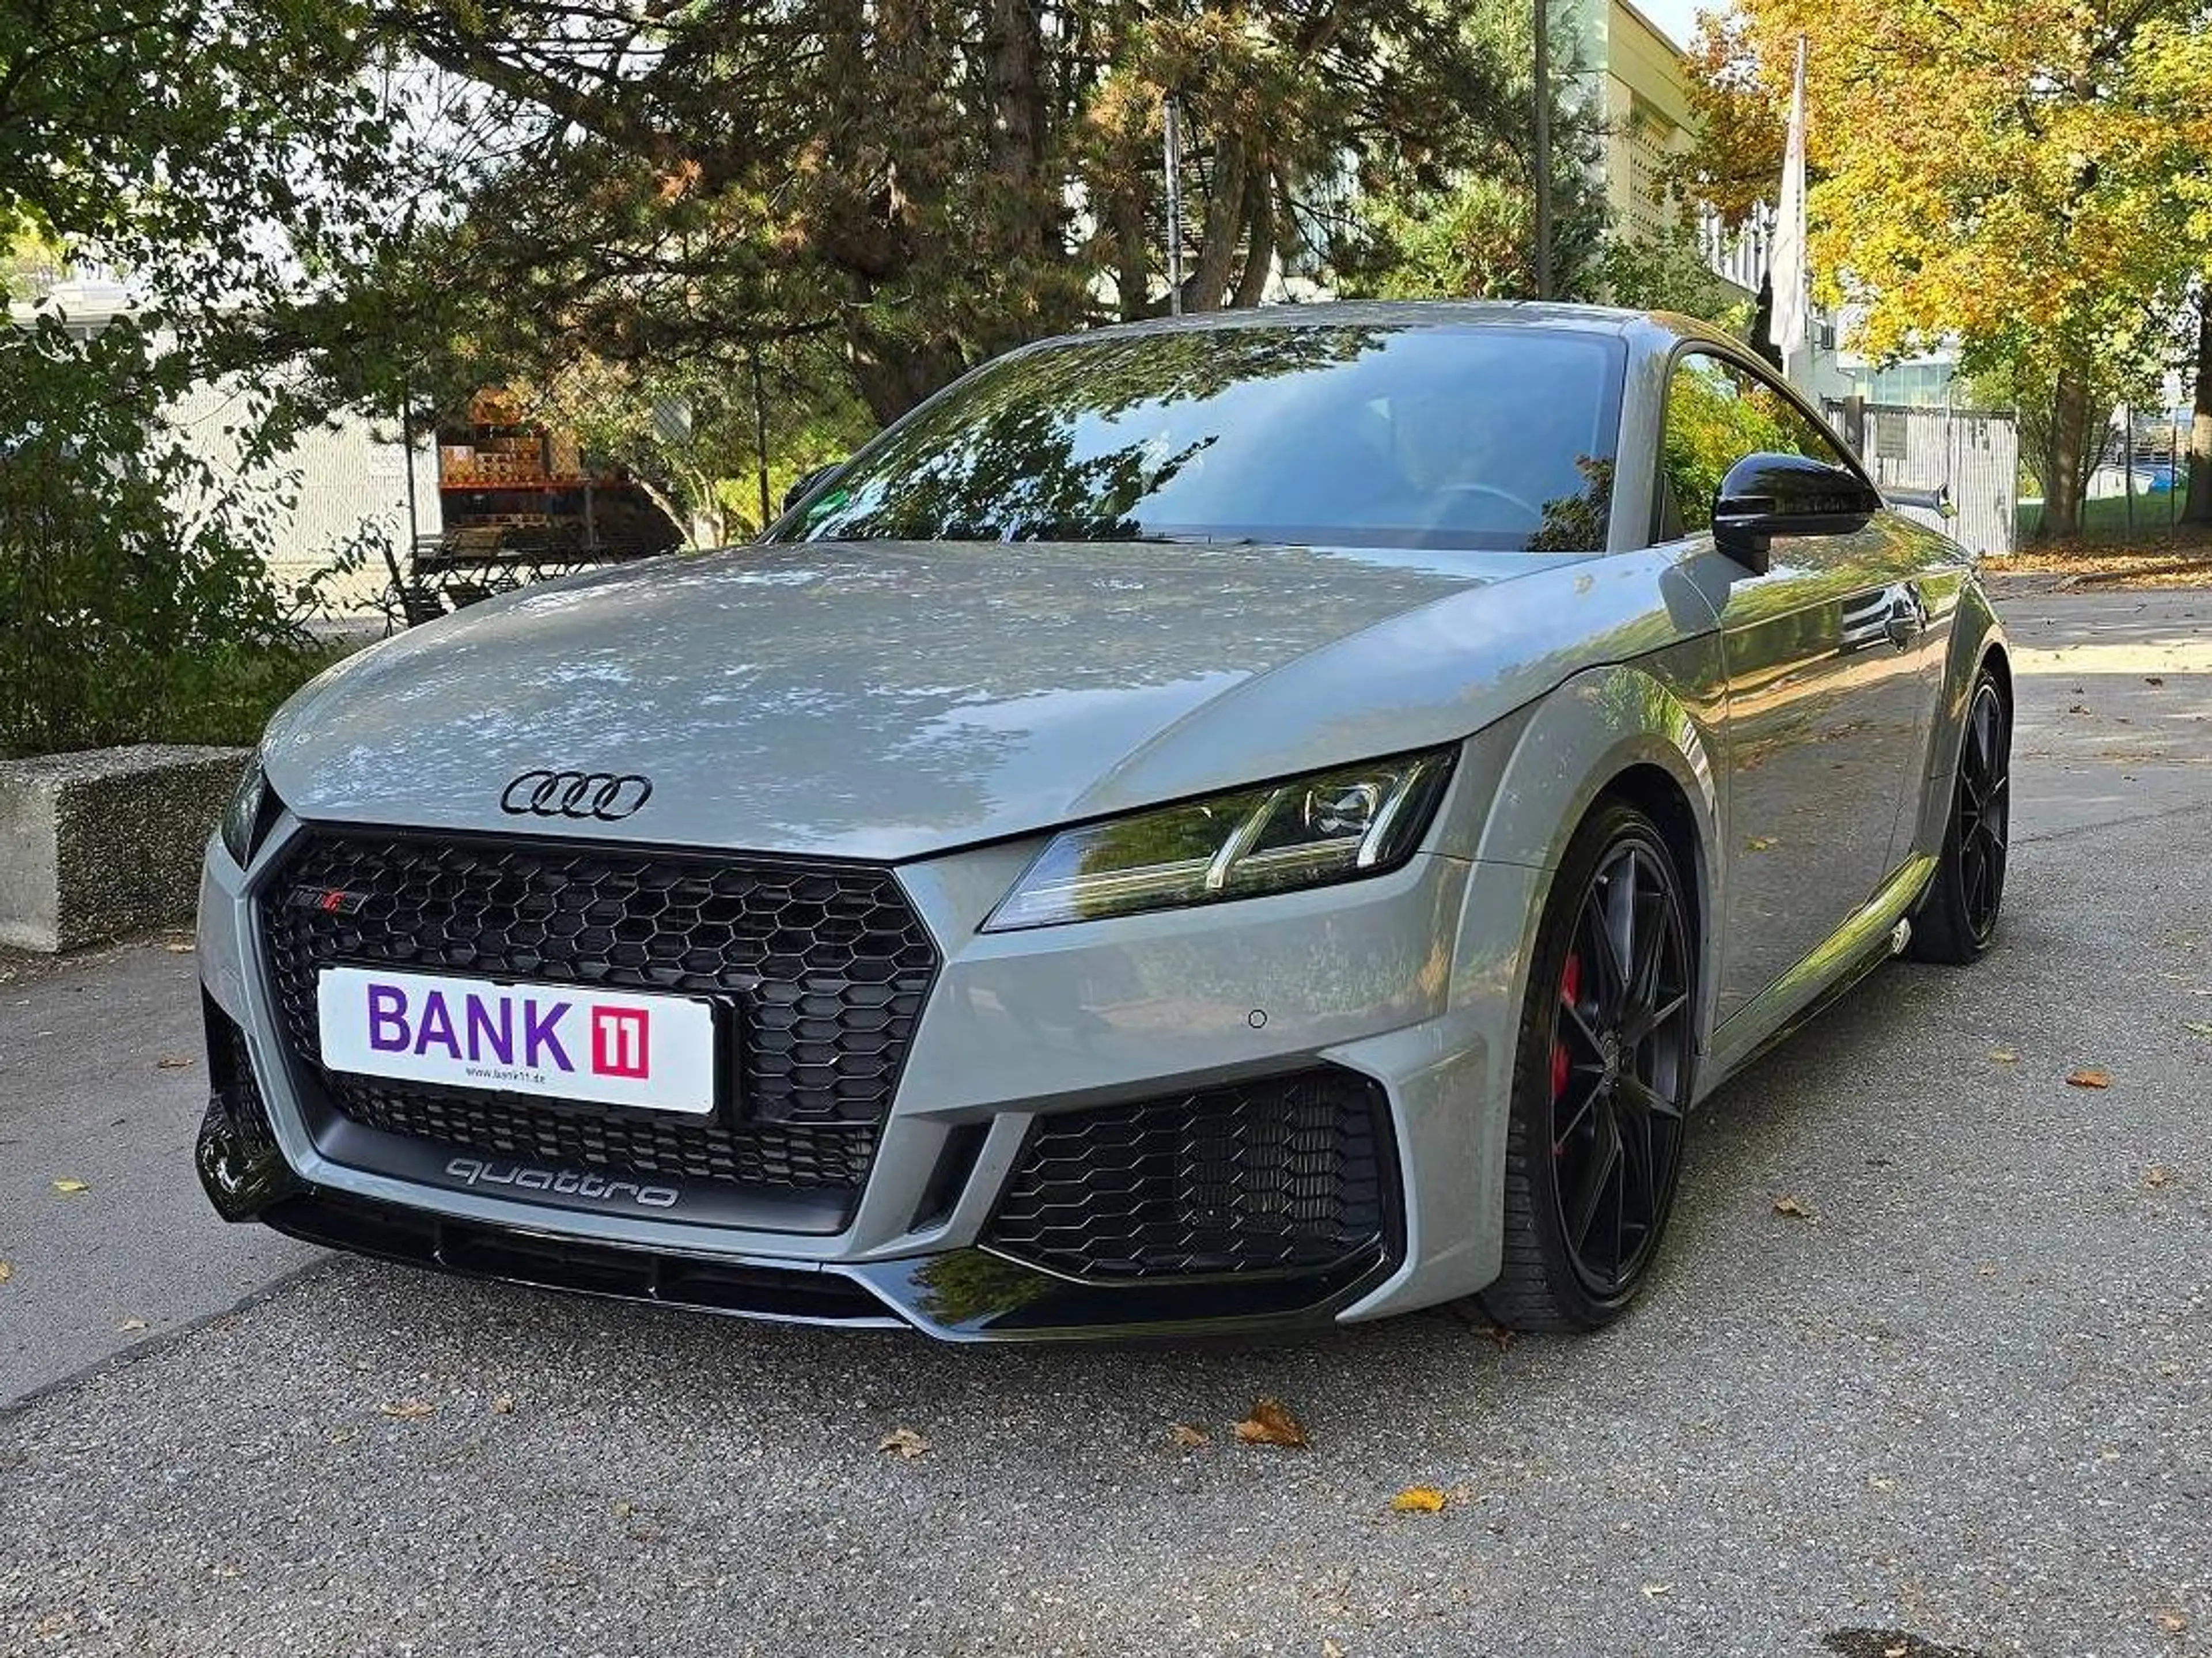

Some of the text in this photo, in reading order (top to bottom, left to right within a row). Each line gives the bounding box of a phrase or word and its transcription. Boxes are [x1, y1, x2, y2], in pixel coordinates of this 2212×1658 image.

[368, 983, 641, 1073] BANK 11
[445, 1157, 680, 1207] quattro
